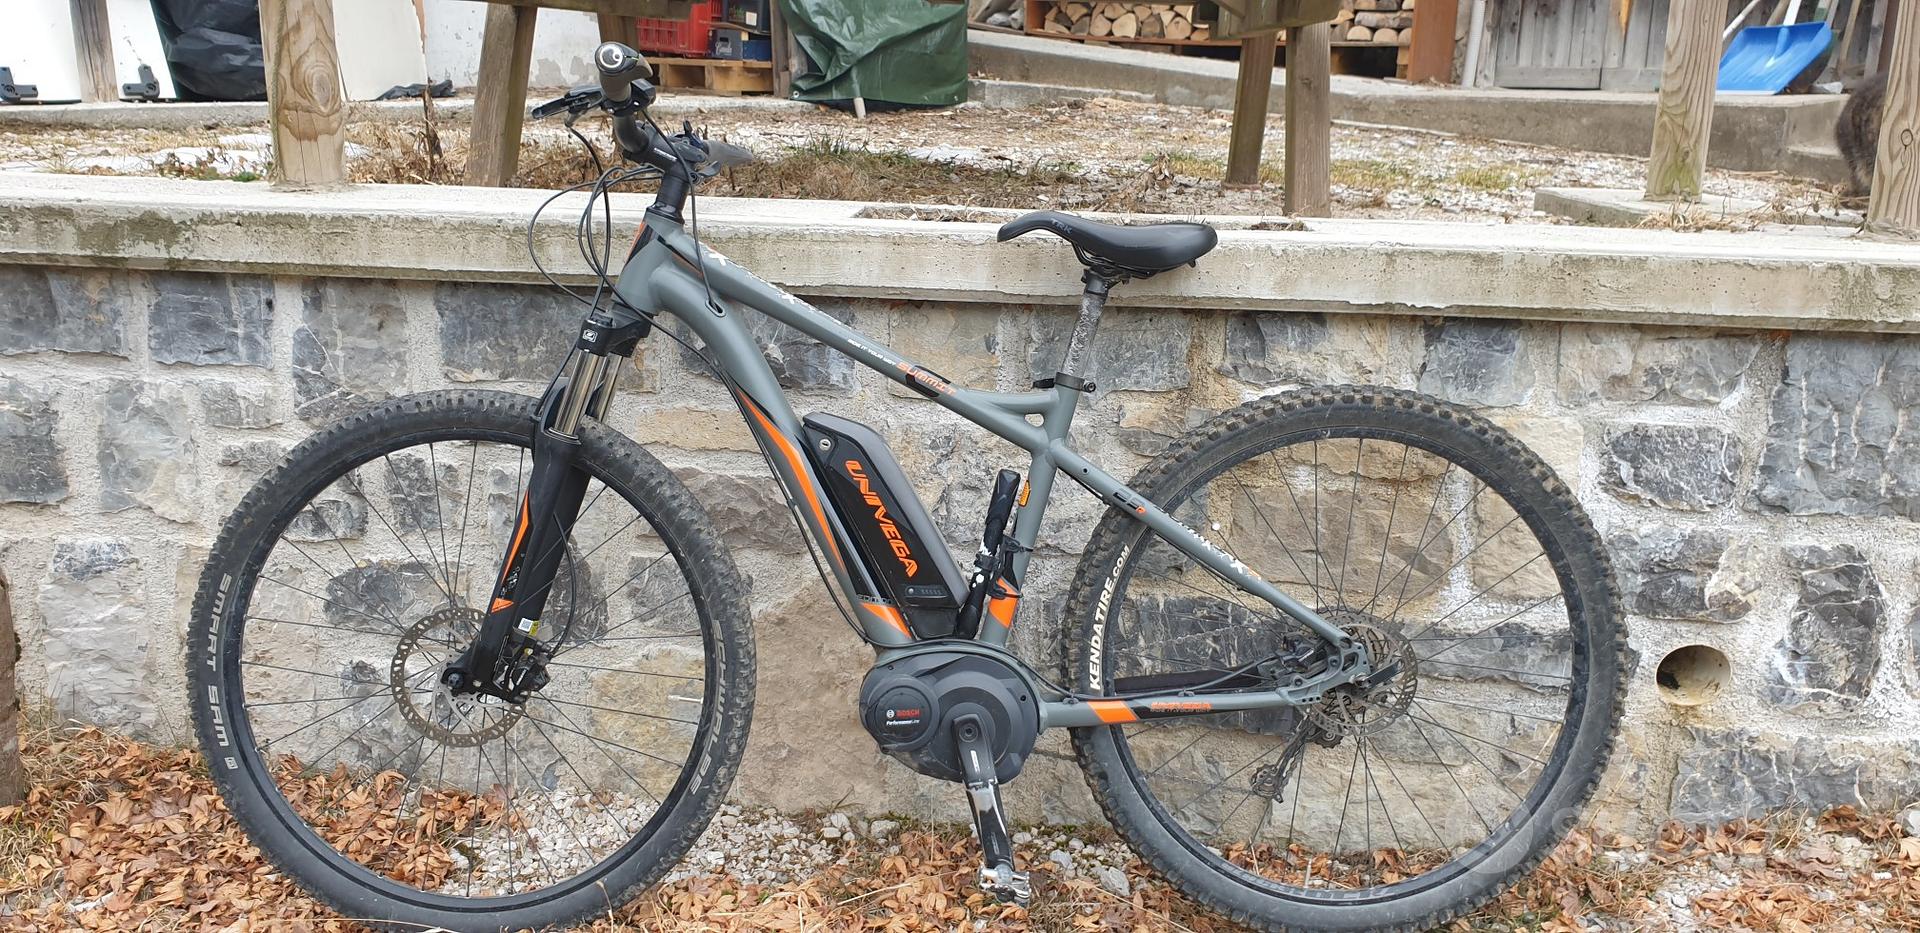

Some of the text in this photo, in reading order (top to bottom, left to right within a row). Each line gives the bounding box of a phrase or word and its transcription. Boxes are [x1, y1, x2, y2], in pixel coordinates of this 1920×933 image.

[845, 460, 919, 578] UNIVEGA
[207, 573, 232, 747] SMART SAM
[1089, 545, 1130, 690] KENDATIRE.COM
[690, 619, 727, 795] SCHWALBE
[896, 709, 920, 718] BOSCH
